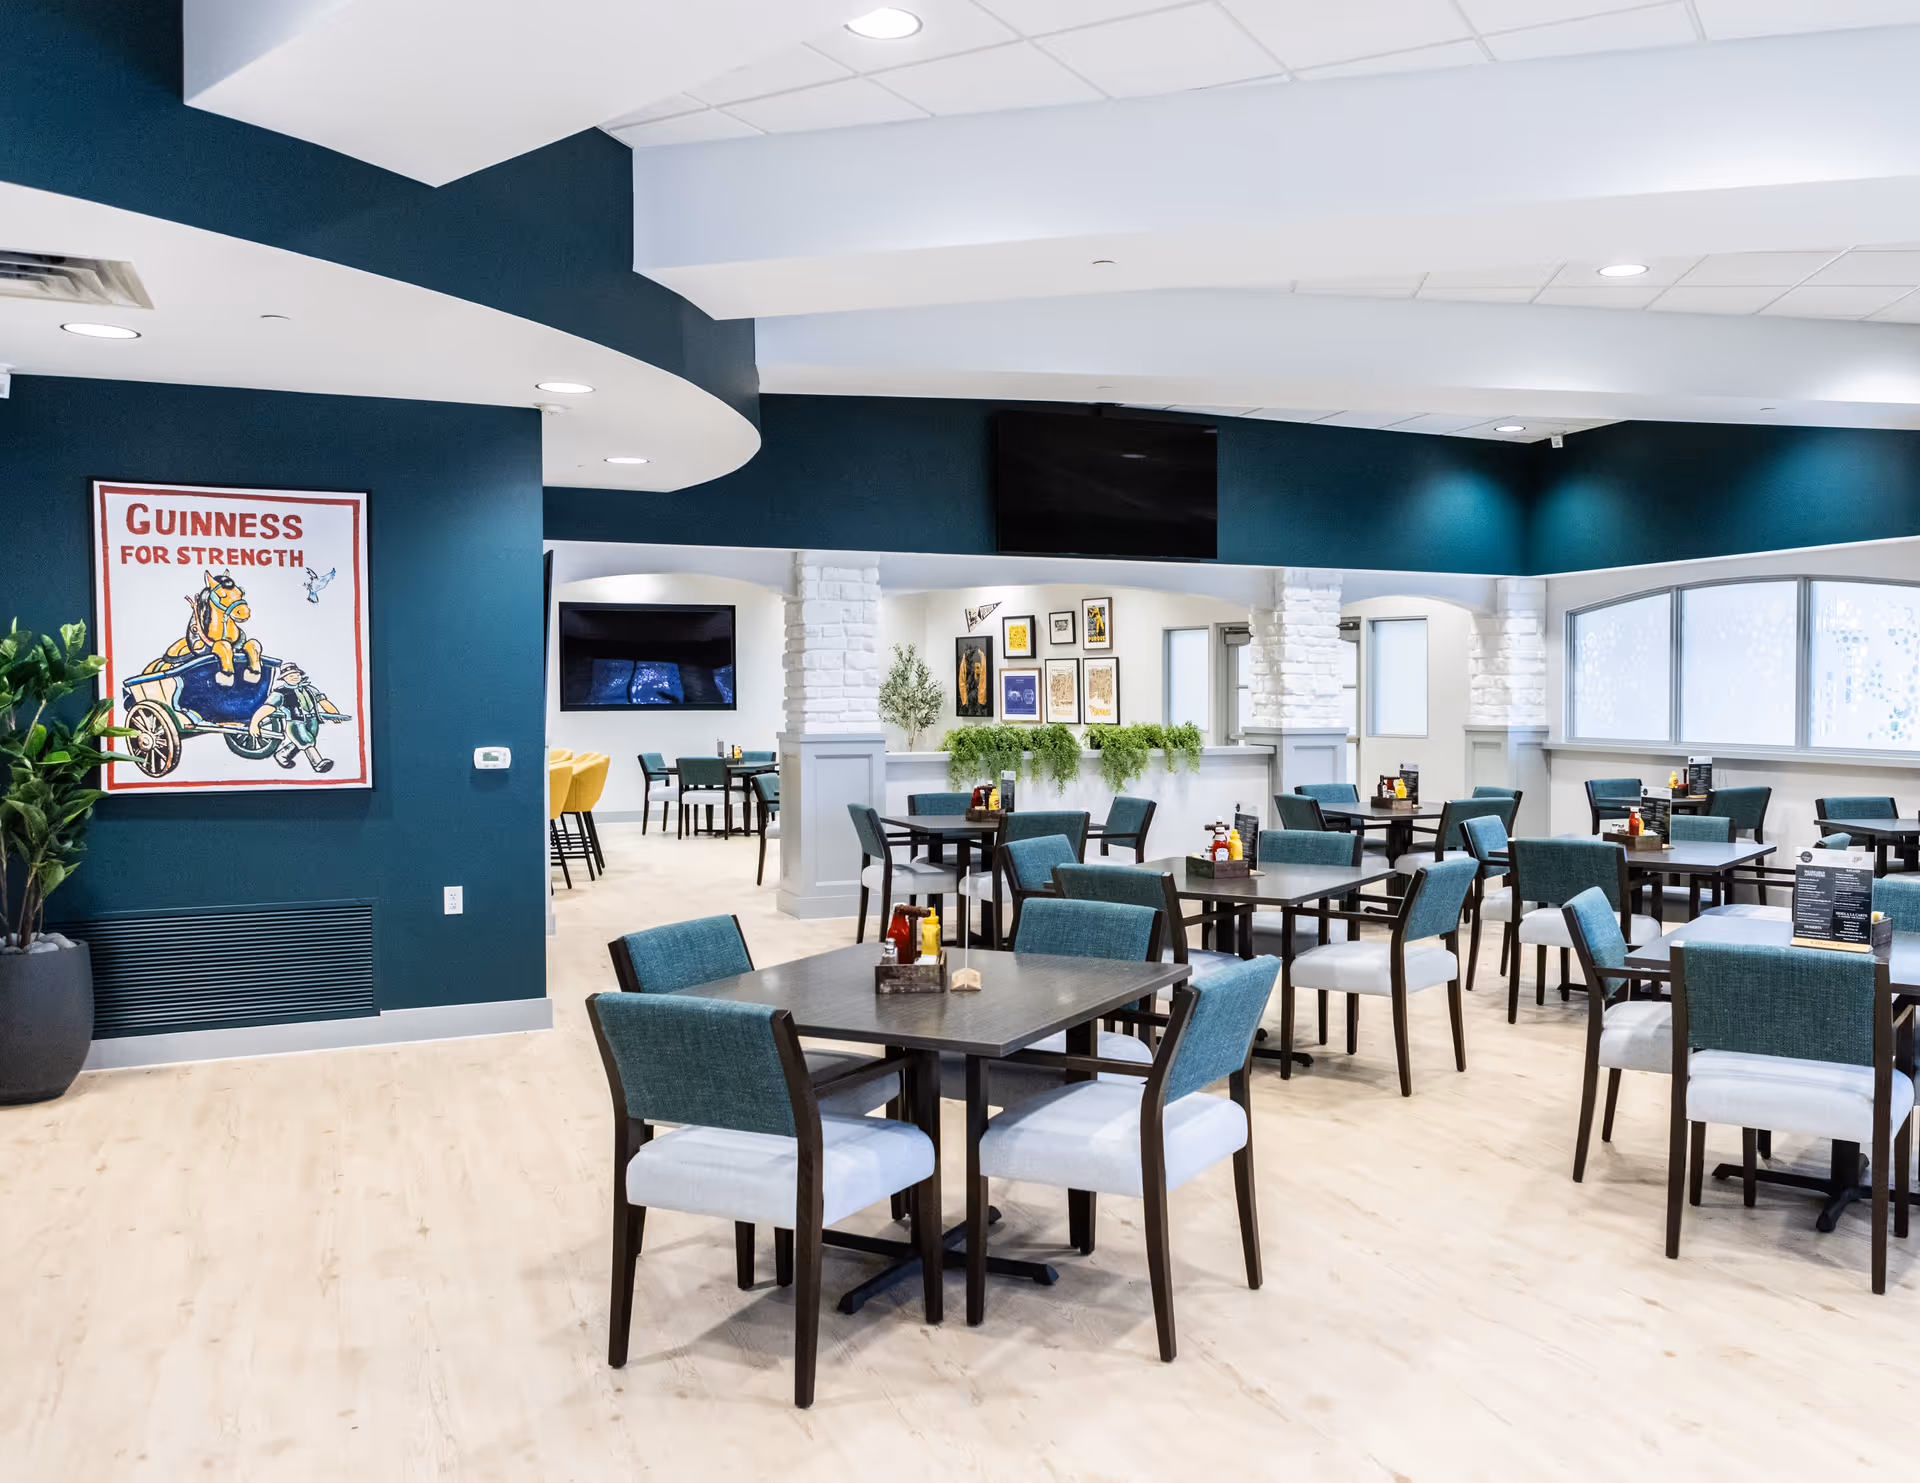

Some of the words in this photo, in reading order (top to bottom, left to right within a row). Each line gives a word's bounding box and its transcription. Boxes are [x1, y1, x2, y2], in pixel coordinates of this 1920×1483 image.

[126, 503, 303, 540] GUINNESS
[120, 545, 171, 565] FOR
[176, 546, 304, 568] STRENGTH
